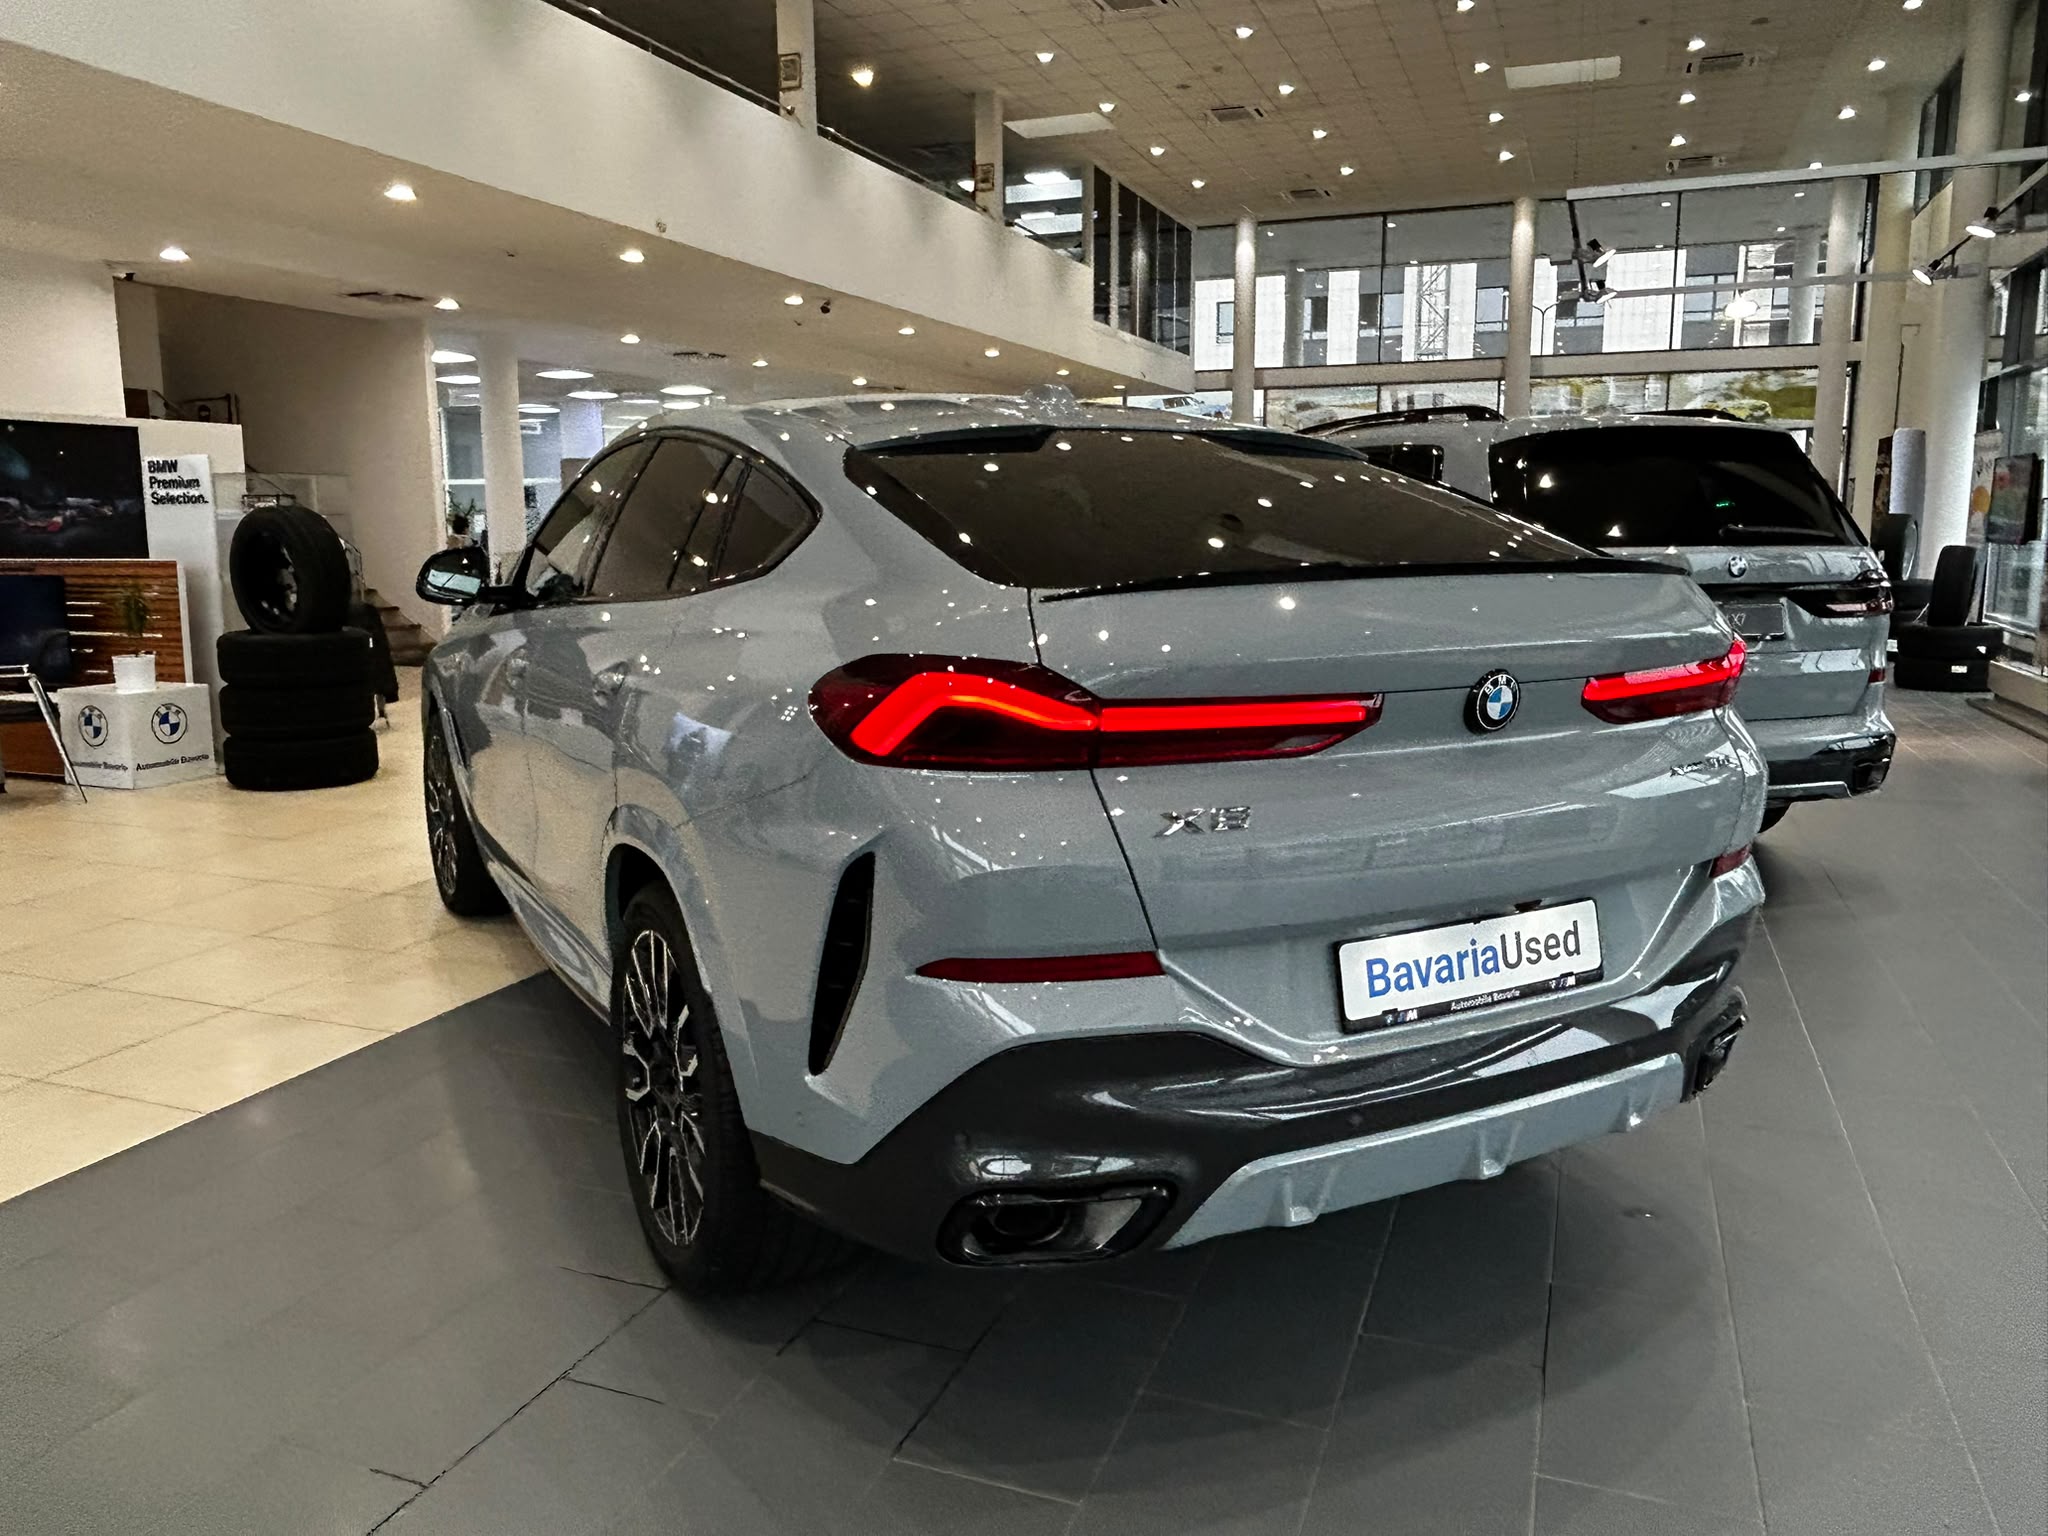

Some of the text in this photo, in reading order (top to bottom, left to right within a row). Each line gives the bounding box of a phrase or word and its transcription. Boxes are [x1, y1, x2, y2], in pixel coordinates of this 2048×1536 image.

[147, 459, 178, 473] BMW
[149, 475, 201, 489] Premium
[151, 491, 209, 505] Selection.
[1365, 920, 1581, 998] BavariaUsed
